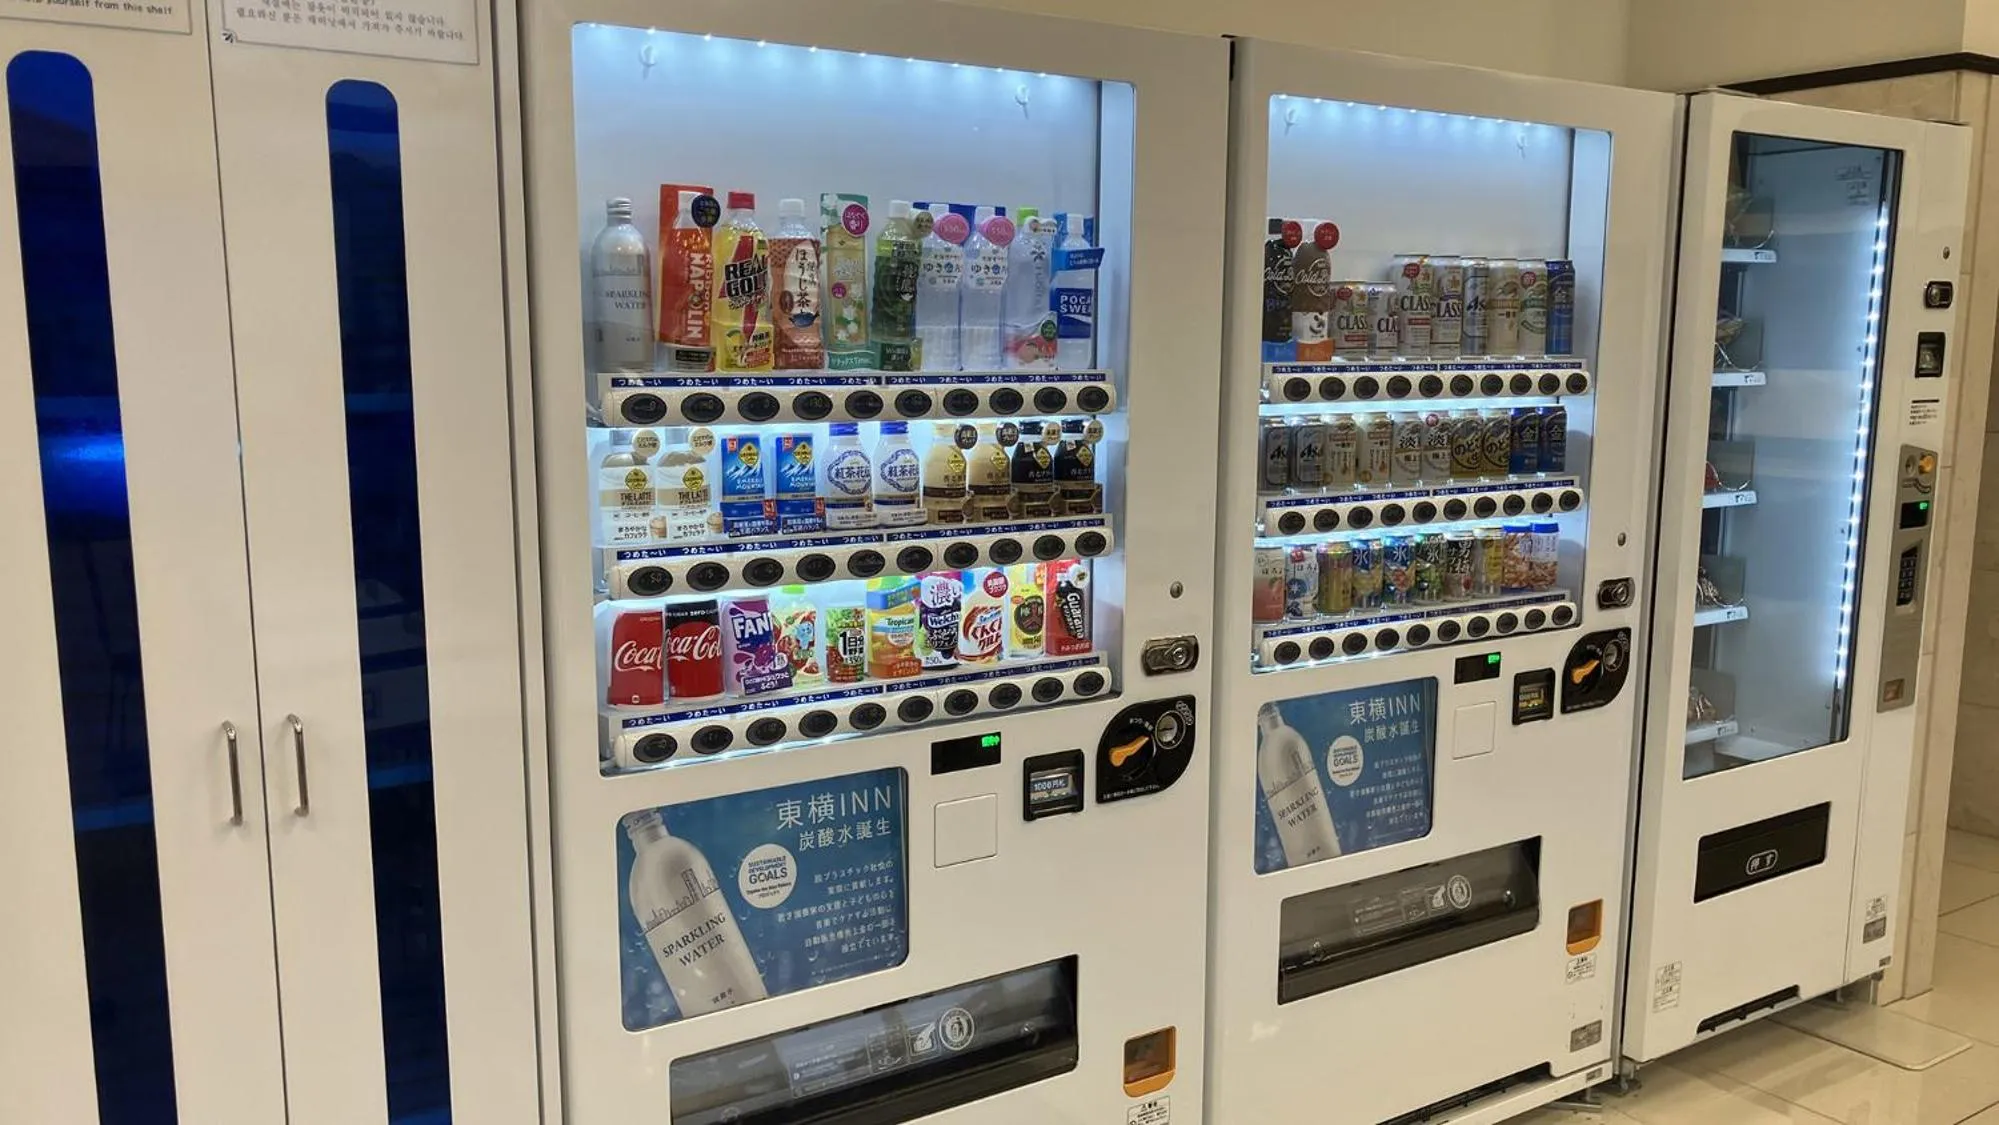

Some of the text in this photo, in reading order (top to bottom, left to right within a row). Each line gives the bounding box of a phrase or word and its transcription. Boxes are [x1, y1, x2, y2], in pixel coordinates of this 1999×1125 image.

[94, 1, 119, 10] from
[123, 3, 143, 13] this
[147, 5, 172, 15] shelf
[725, 253, 768, 281] REAL
[686, 253, 704, 338] NAPOLIN
[1060, 295, 1091, 304] POCA
[1060, 304, 1091, 313] SWE
[1349, 693, 1421, 725] 東横INN
[776, 786, 893, 831] 東横INN
[1287, 803, 1318, 828] WATER
[799, 817, 892, 852] 炭酸水誕生
[749, 867, 788, 884] GOALS
[662, 912, 726, 958] SPARKLING
[679, 934, 726, 967] WATER
